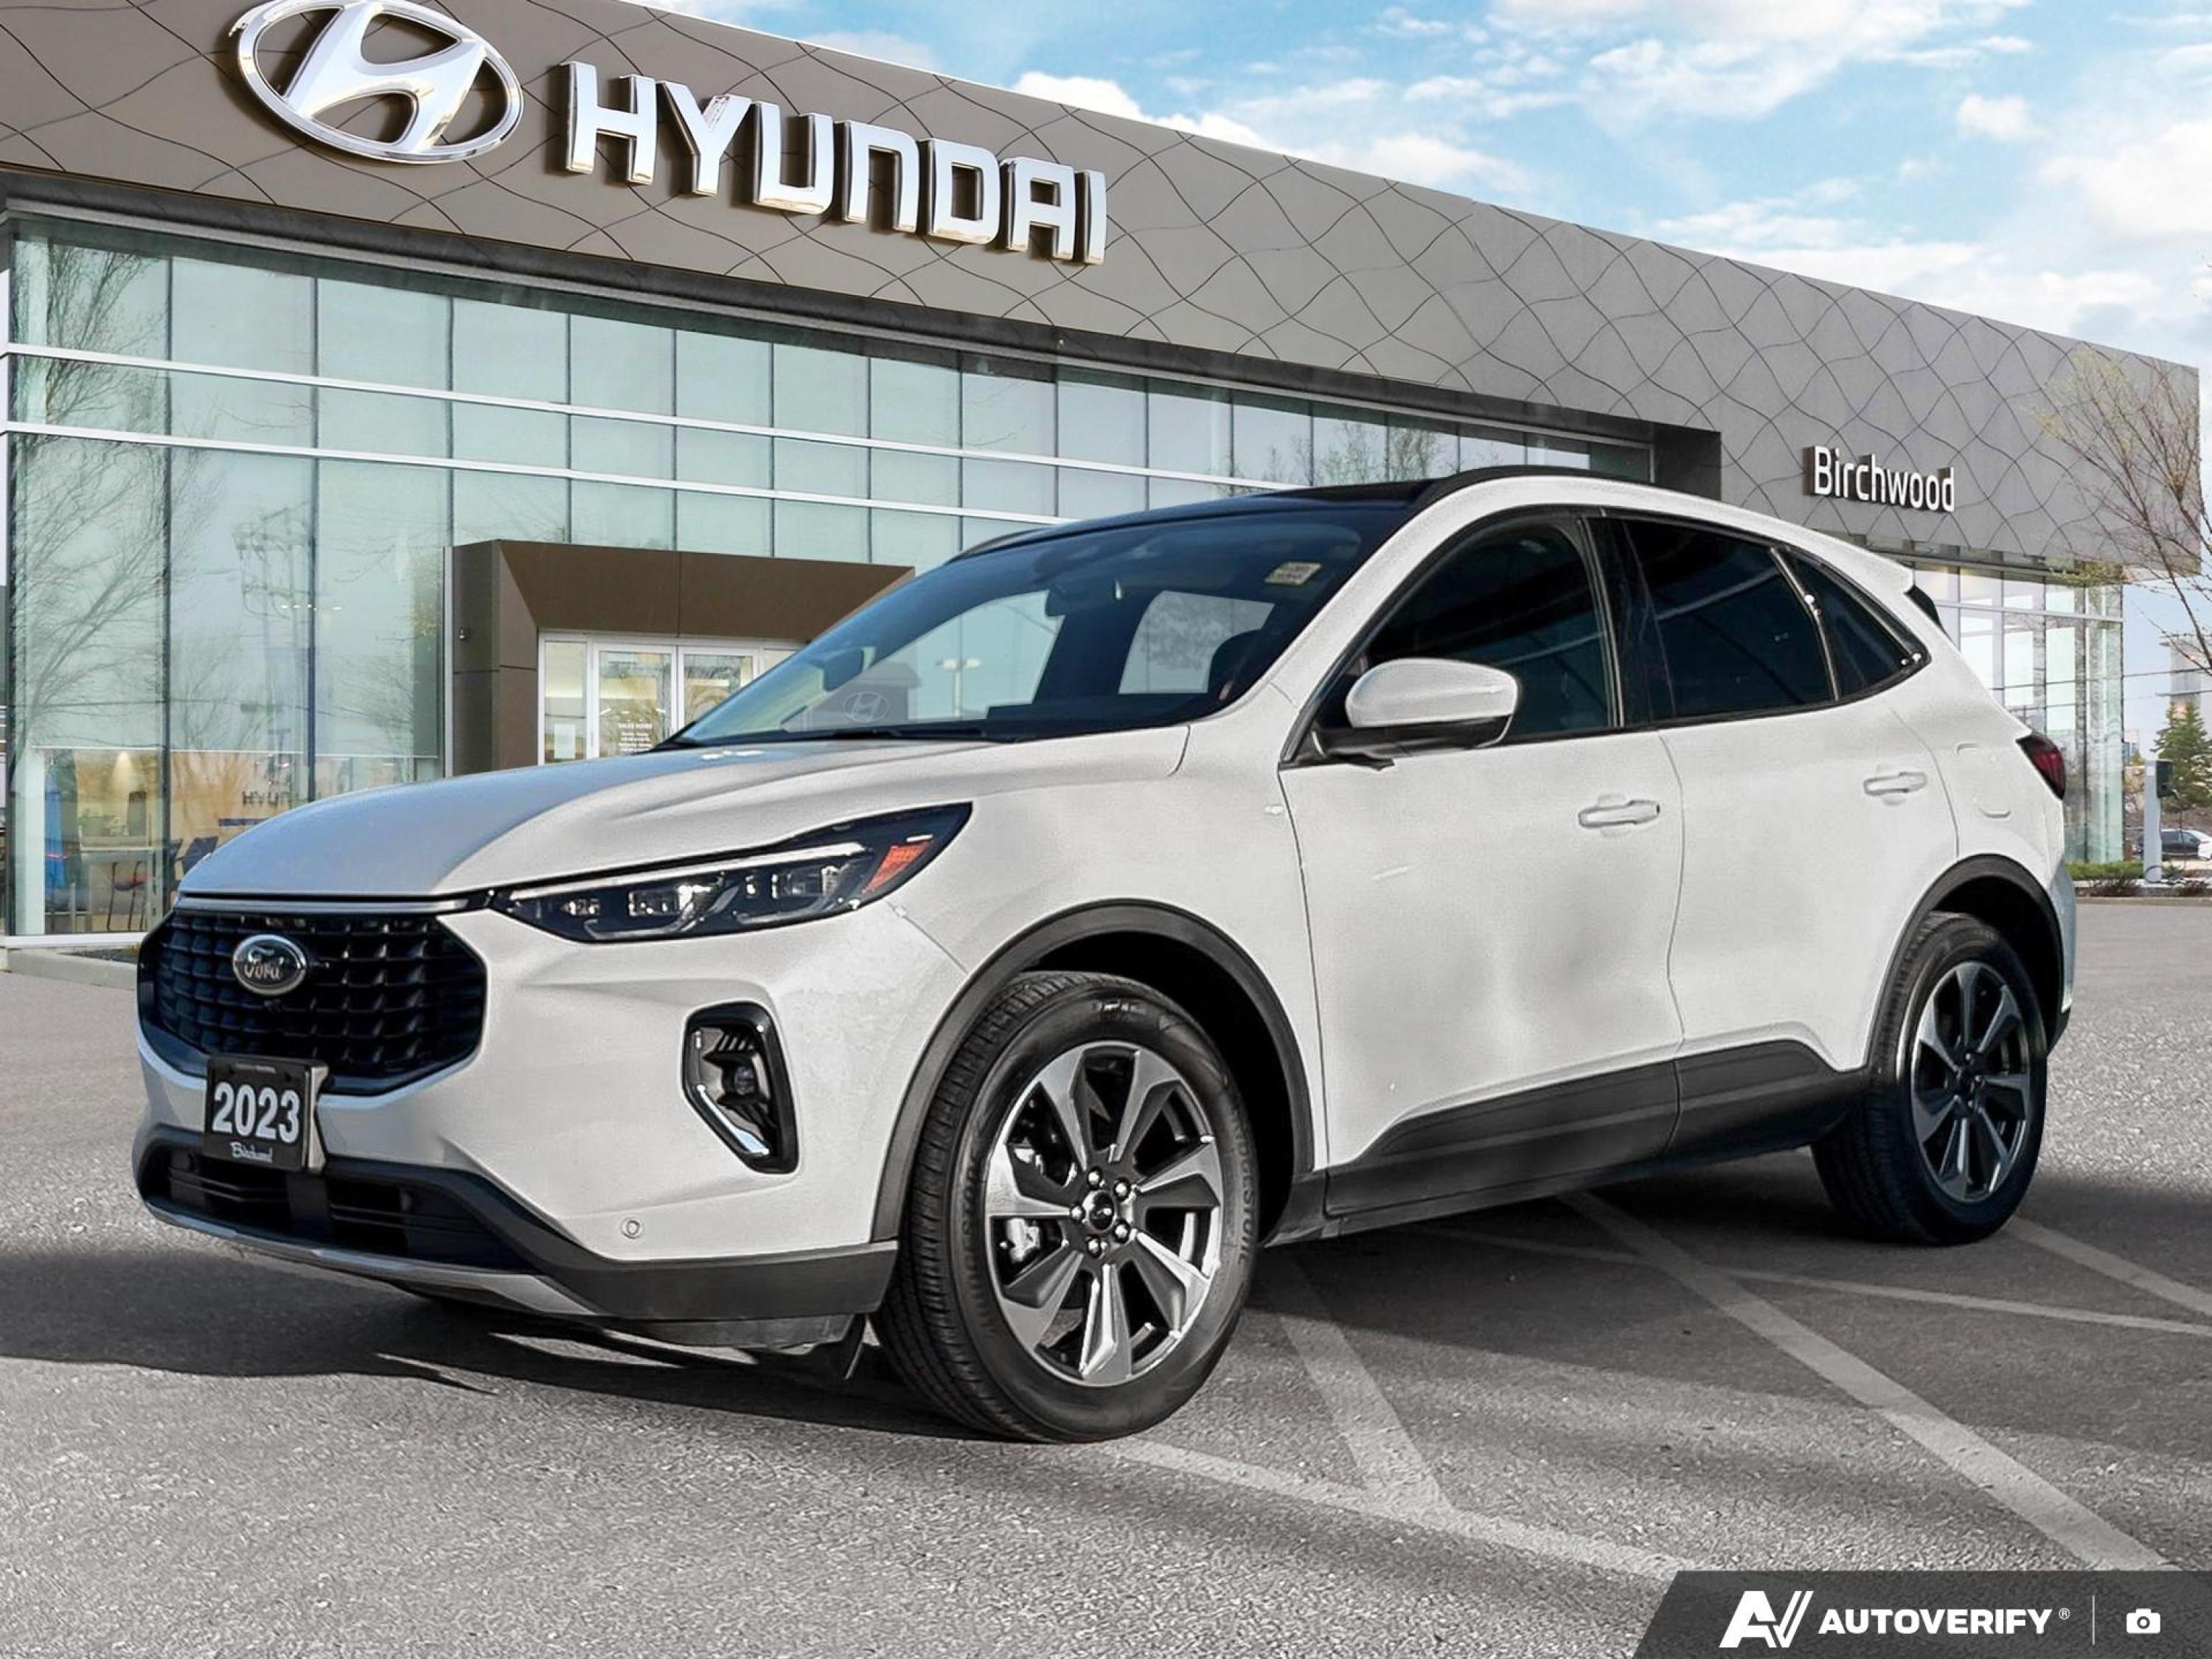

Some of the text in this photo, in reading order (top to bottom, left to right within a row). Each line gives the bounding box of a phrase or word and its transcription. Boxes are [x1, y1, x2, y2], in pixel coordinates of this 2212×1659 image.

[560, 62, 1106, 265] HYUNDAI
[1814, 445, 1955, 512] Birchwood
[212, 1082, 301, 1143] 2023
